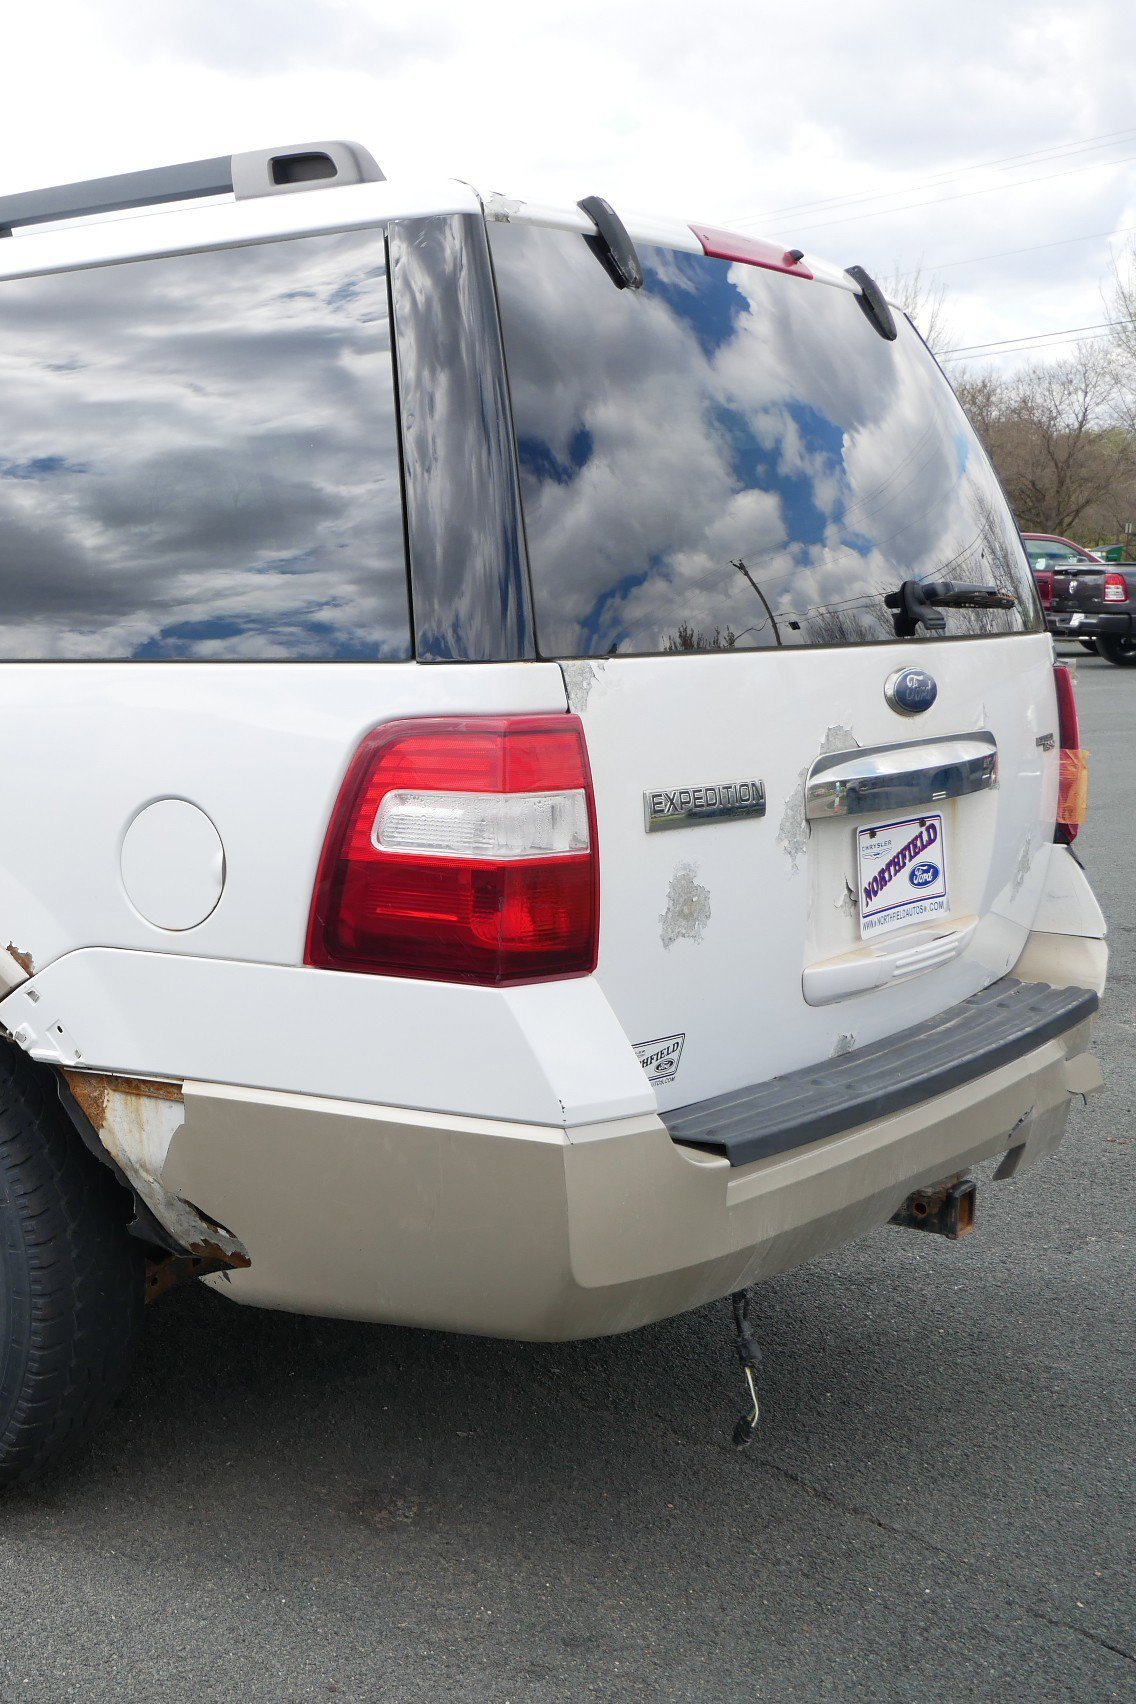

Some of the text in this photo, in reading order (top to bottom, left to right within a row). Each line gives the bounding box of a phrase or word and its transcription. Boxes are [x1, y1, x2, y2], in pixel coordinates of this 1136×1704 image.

[650, 780, 765, 814] EXPEDITION
[862, 840, 892, 851] CHRYSLER
[863, 823, 938, 908] NORTHFIELD
[913, 865, 934, 884] Ford
[639, 1041, 680, 1068] HFIELD
